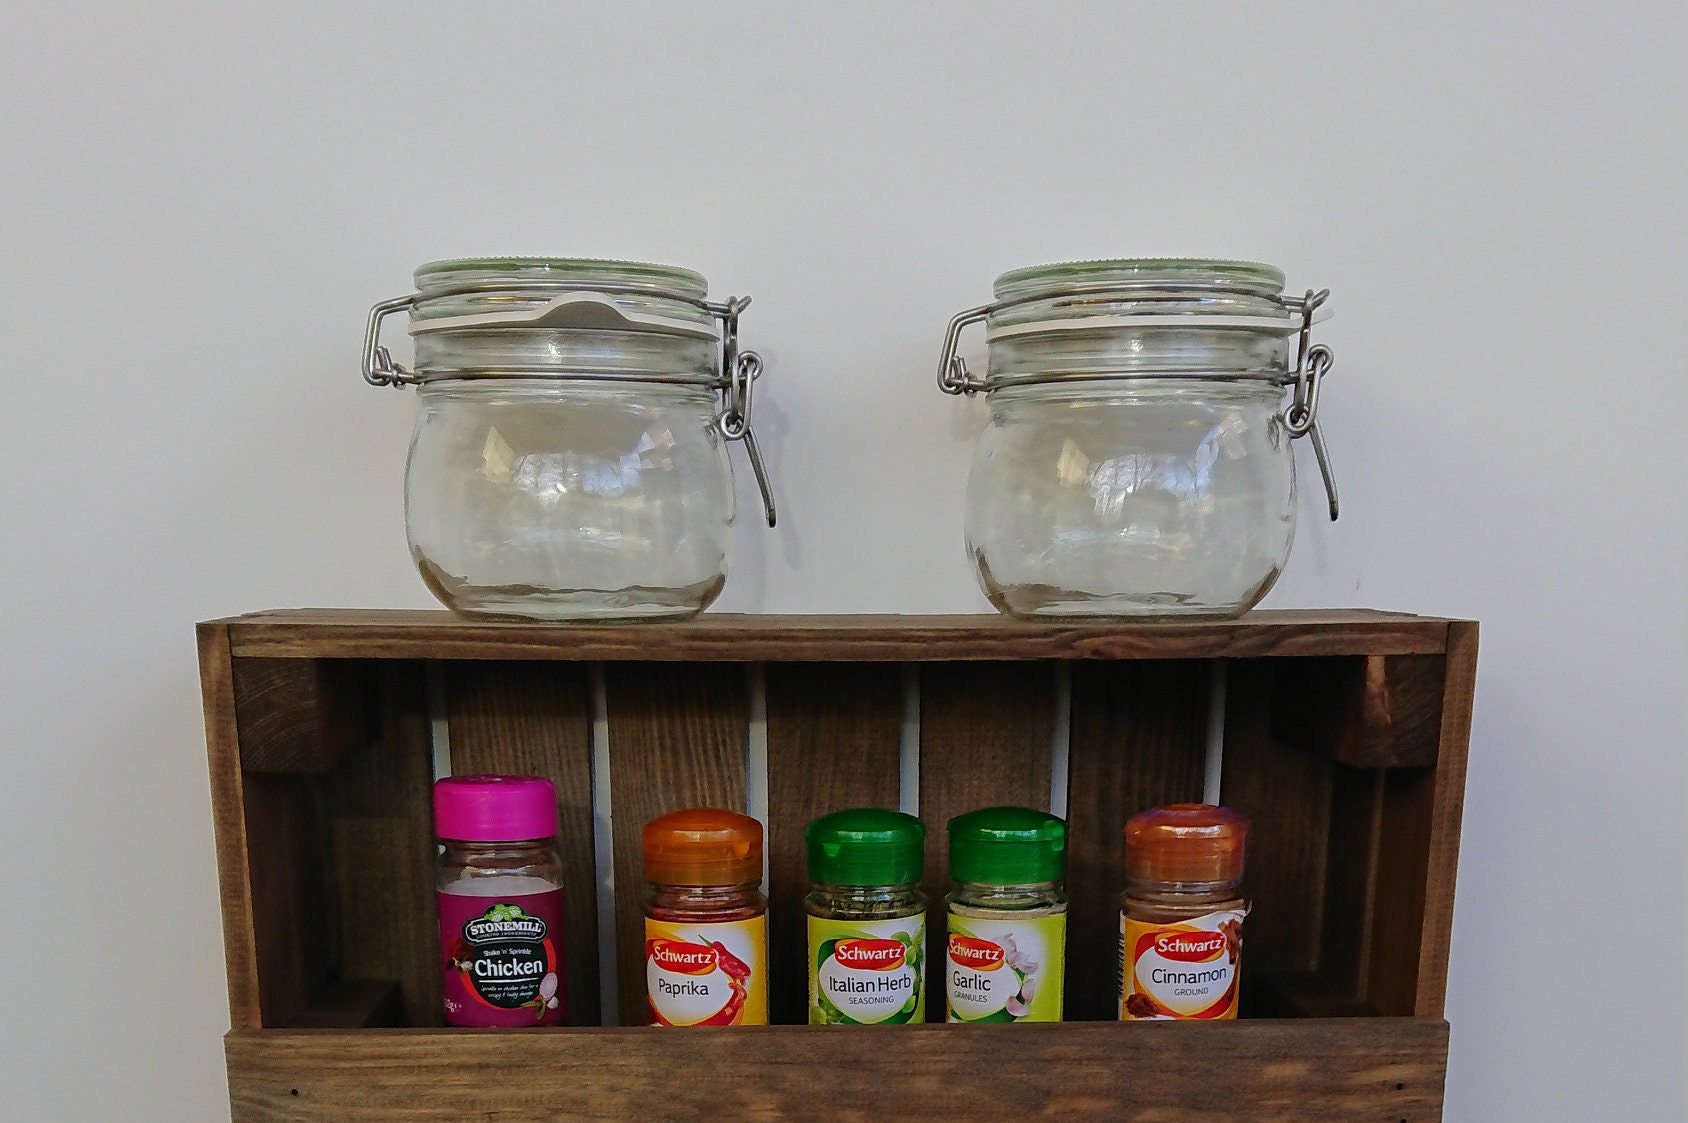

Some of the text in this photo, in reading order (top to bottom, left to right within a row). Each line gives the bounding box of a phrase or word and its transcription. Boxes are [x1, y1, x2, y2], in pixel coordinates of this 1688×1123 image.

[470, 921, 542, 936] STONEMILL
[508, 948, 532, 957] Sprinkle
[838, 945, 902, 960] Schwartz
[949, 939, 999, 961] Schwartz
[1158, 938, 1222, 953] Schwartz
[654, 946, 711, 964] Schwartz
[475, 958, 543, 977] Chicken
[1151, 967, 1227, 984] Cinnamon
[658, 978, 709, 998] Paprika
[829, 973, 911, 993] Italian Herb
[953, 970, 991, 991] Garlic
[954, 990, 988, 1003] GRANULES
[1174, 987, 1209, 996] GROUND
[848, 996, 894, 1005] SEASONING
